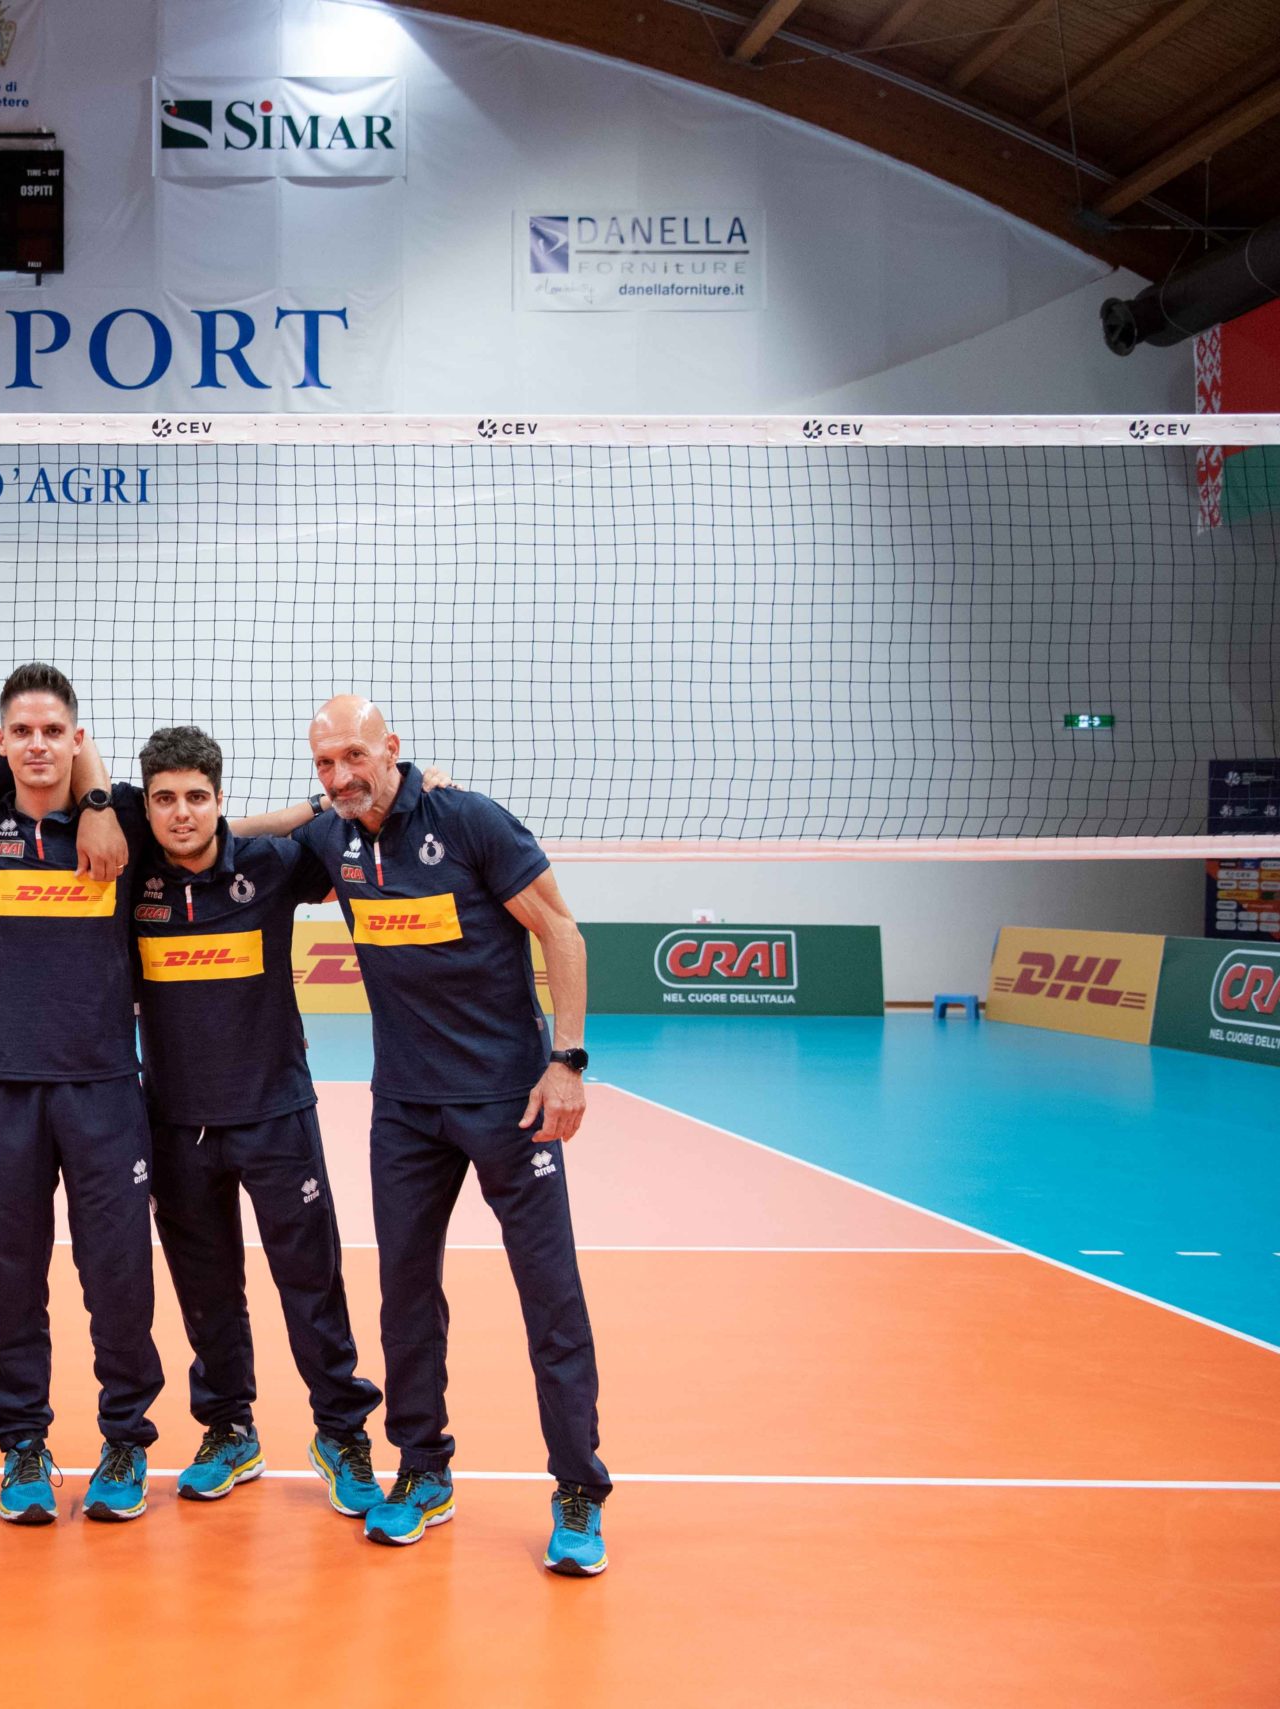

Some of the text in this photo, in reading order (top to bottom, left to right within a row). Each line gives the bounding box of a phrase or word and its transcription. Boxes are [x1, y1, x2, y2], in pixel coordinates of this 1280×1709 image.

[5, 81, 17, 92] di
[20, 185, 53, 196] OSPITI
[577, 217, 748, 245] DANELLA
[618, 283, 745, 296] danellaforniture.it
[176, 422, 213, 434] CEV
[501, 422, 539, 434] CEV
[827, 423, 863, 435] CEV
[1154, 423, 1191, 436] CEV
[15, 885, 90, 902] DHL
[368, 914, 427, 931] DHL
[163, 949, 236, 967] DHL
[666, 940, 787, 978] CRAI
[1011, 951, 1124, 1006] DHL
[663, 993, 796, 1004] NEL CUORE DELL'ITALIA
[1209, 1028, 1225, 1041] NEL
[1226, 1030, 1254, 1045] CUORE
